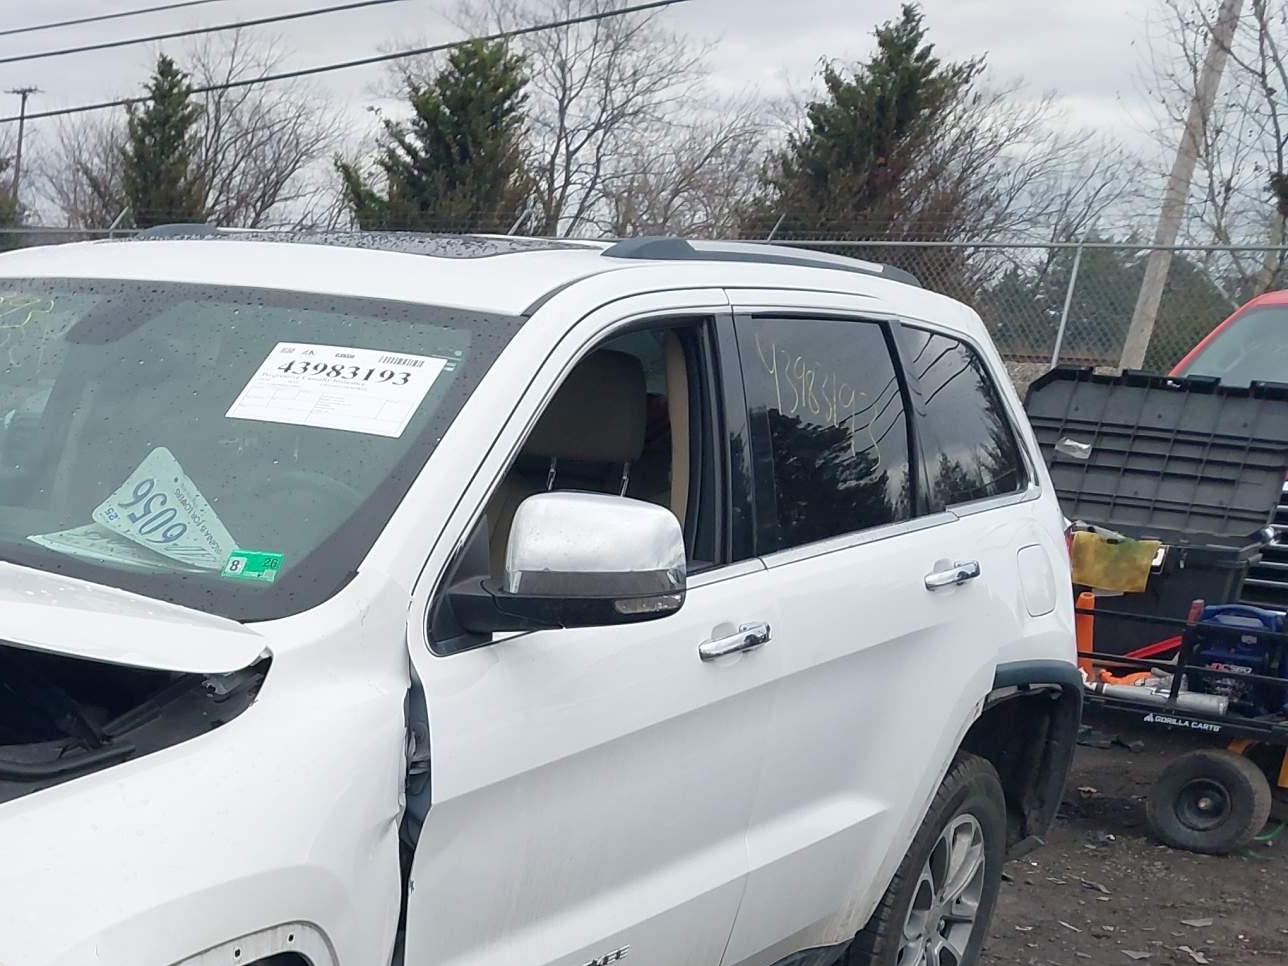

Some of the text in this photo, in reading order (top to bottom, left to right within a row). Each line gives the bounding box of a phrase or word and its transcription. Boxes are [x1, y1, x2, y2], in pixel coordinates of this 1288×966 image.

[276, 359, 412, 386] 43983193
[118, 478, 187, 544] 6056
[229, 559, 240, 572] 8
[1154, 715, 1190, 728] GORILLA
